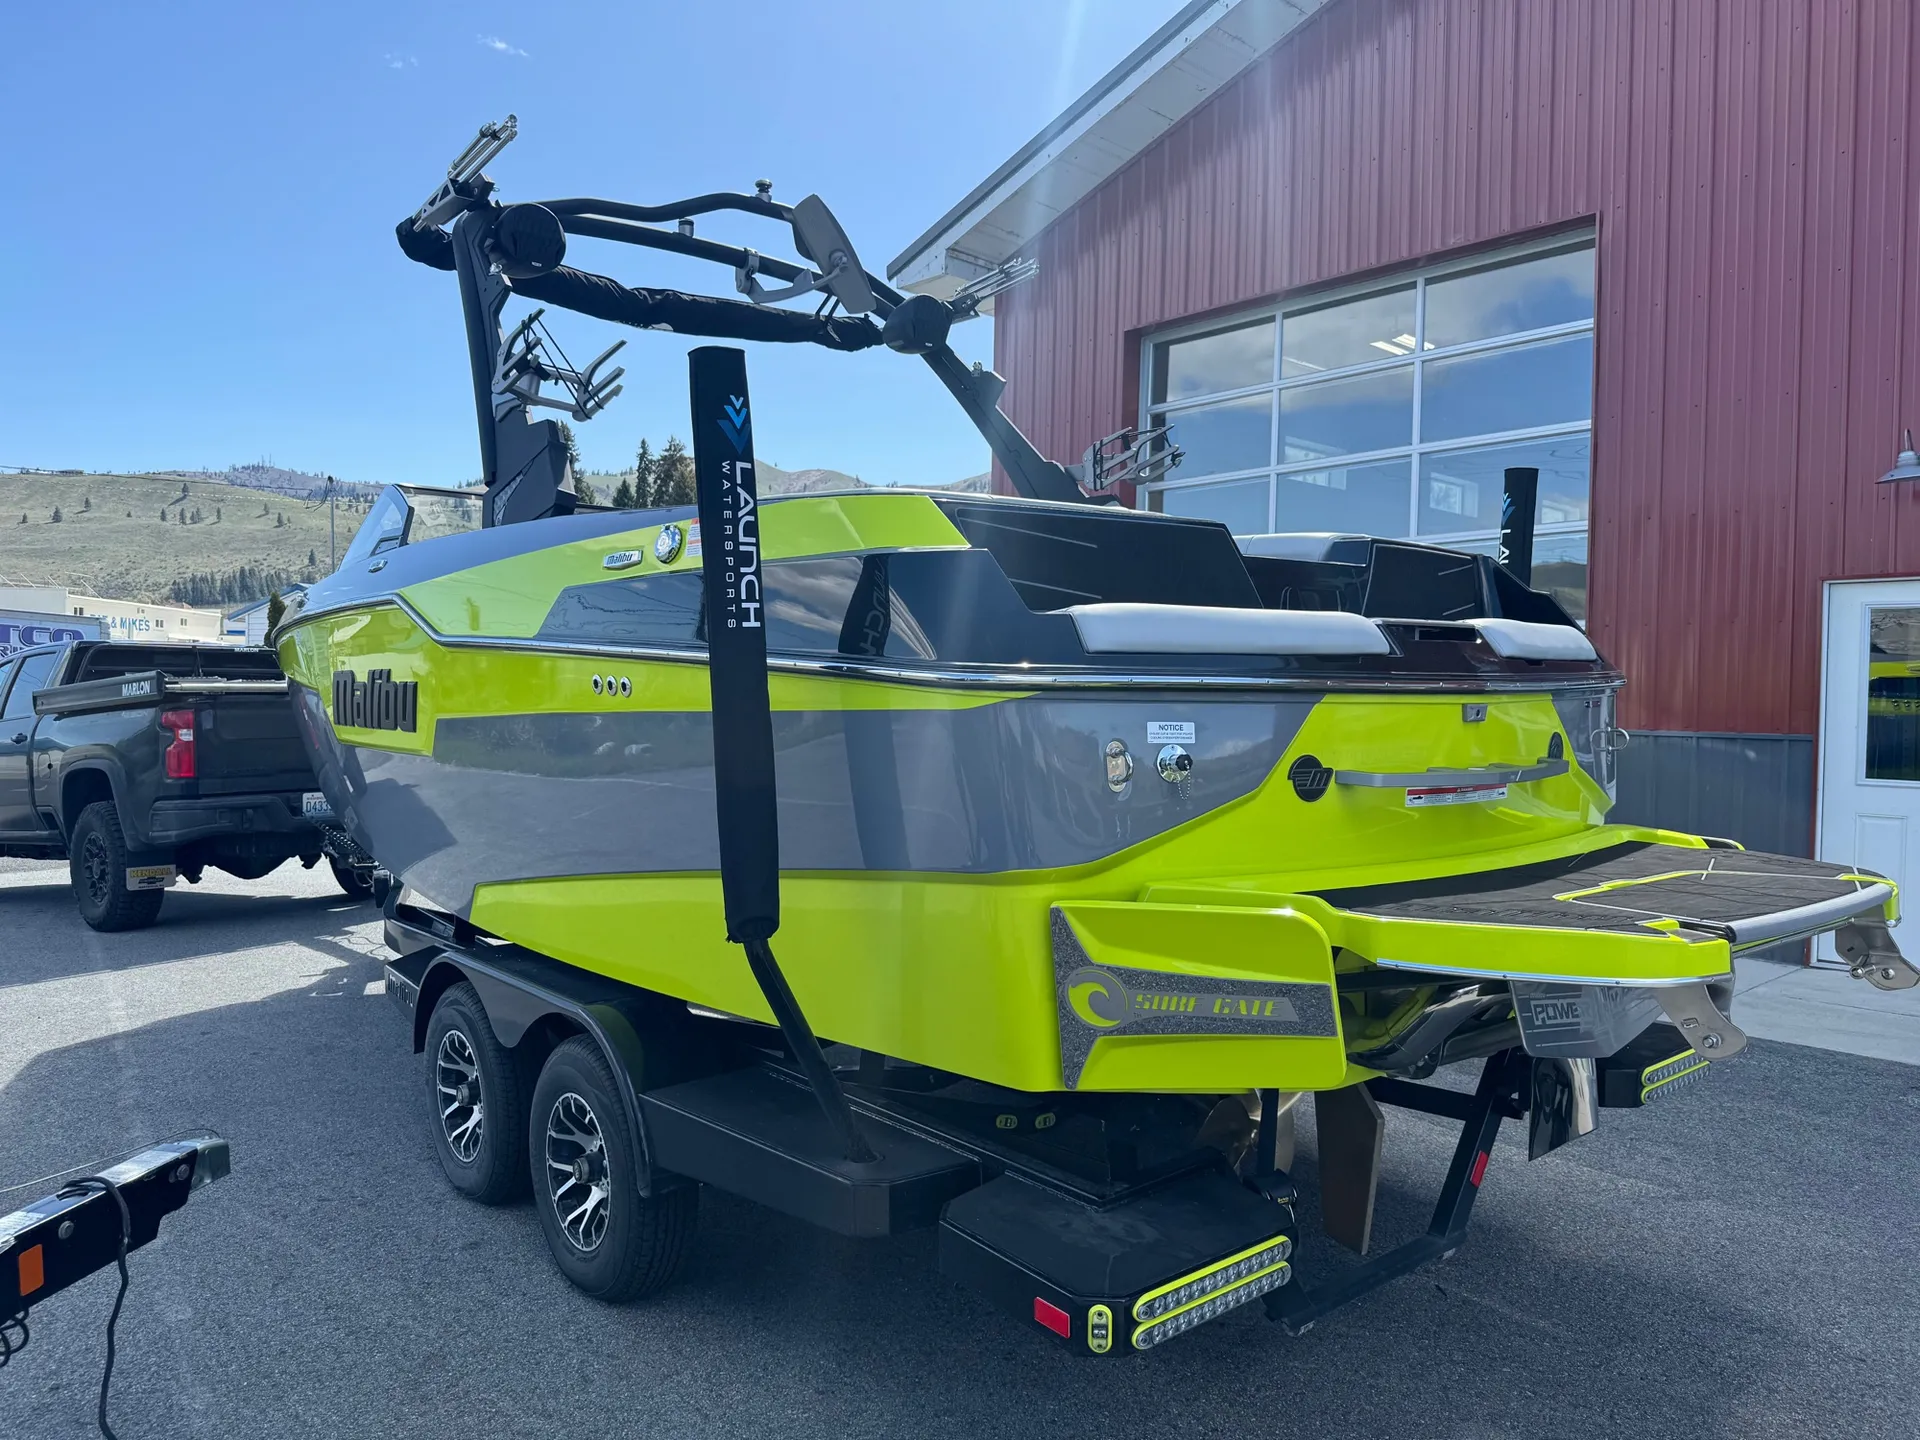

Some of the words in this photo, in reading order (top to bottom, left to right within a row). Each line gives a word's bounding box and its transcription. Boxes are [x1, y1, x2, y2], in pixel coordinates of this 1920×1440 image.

[722, 460, 736, 628] WATERSPORTS
[736, 461, 761, 628] LAUNCH
[111, 617, 117, 628] &
[122, 680, 151, 697] MARLON
[1135, 993, 1202, 1012] SURF
[1213, 997, 1283, 1017] GATE
